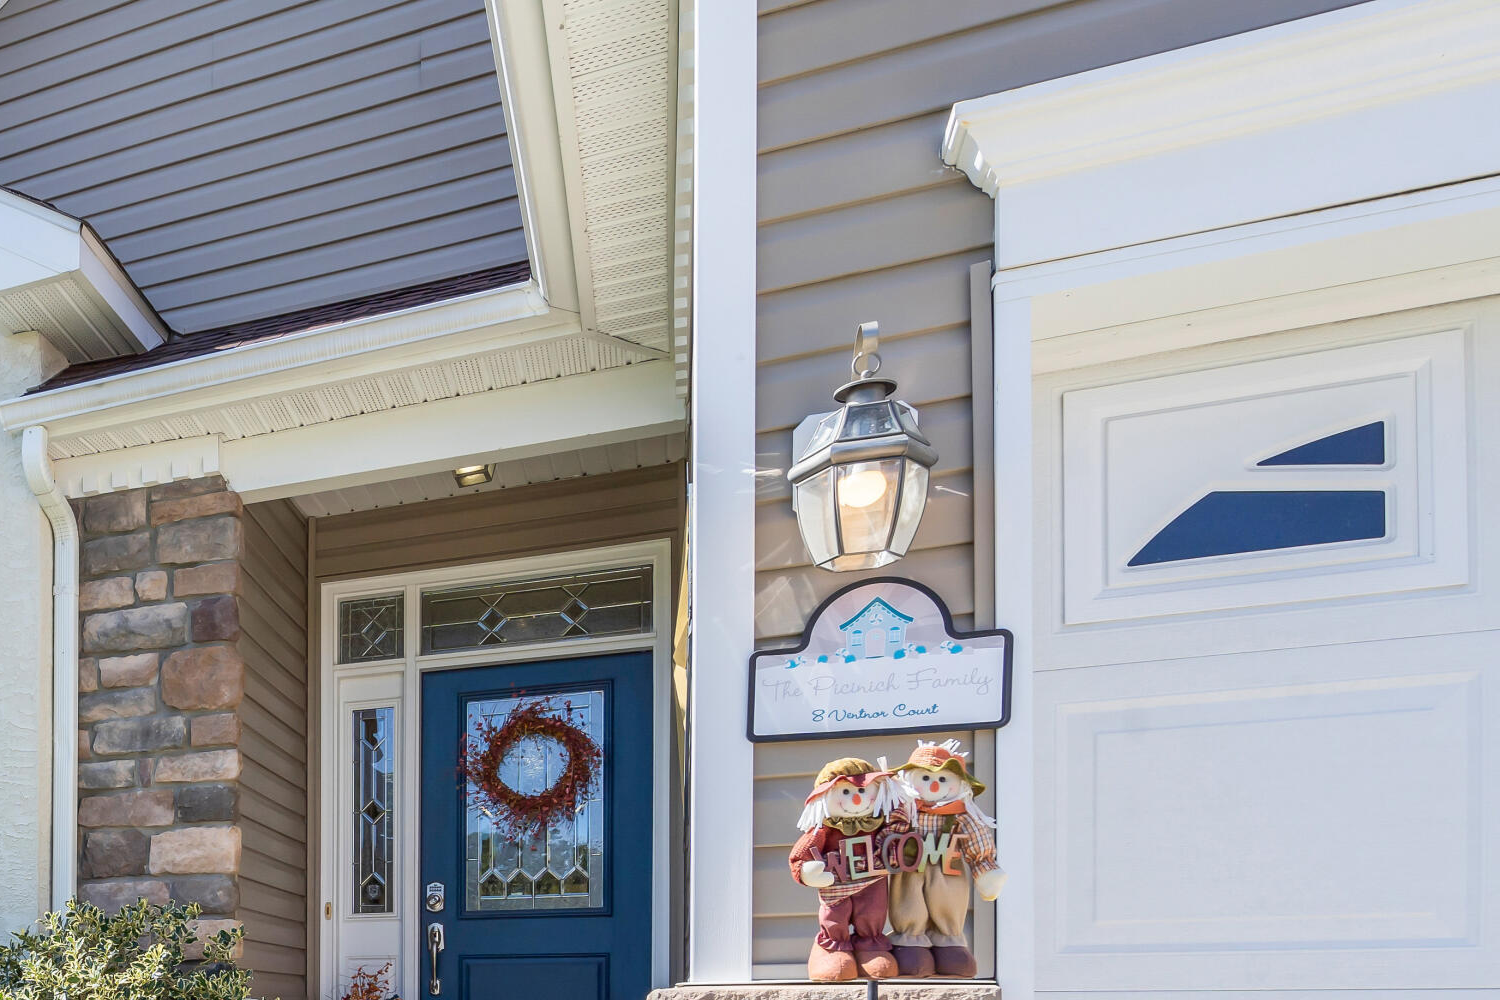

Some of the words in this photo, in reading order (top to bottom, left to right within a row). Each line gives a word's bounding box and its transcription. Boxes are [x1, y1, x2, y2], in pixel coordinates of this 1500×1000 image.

[762, 679, 802, 702] The
[907, 666, 994, 697] Family
[812, 708, 826, 722] 8
[827, 707, 889, 722] Ventnor
[893, 703, 939, 718] Court
[810, 832, 970, 883] WELCOME
